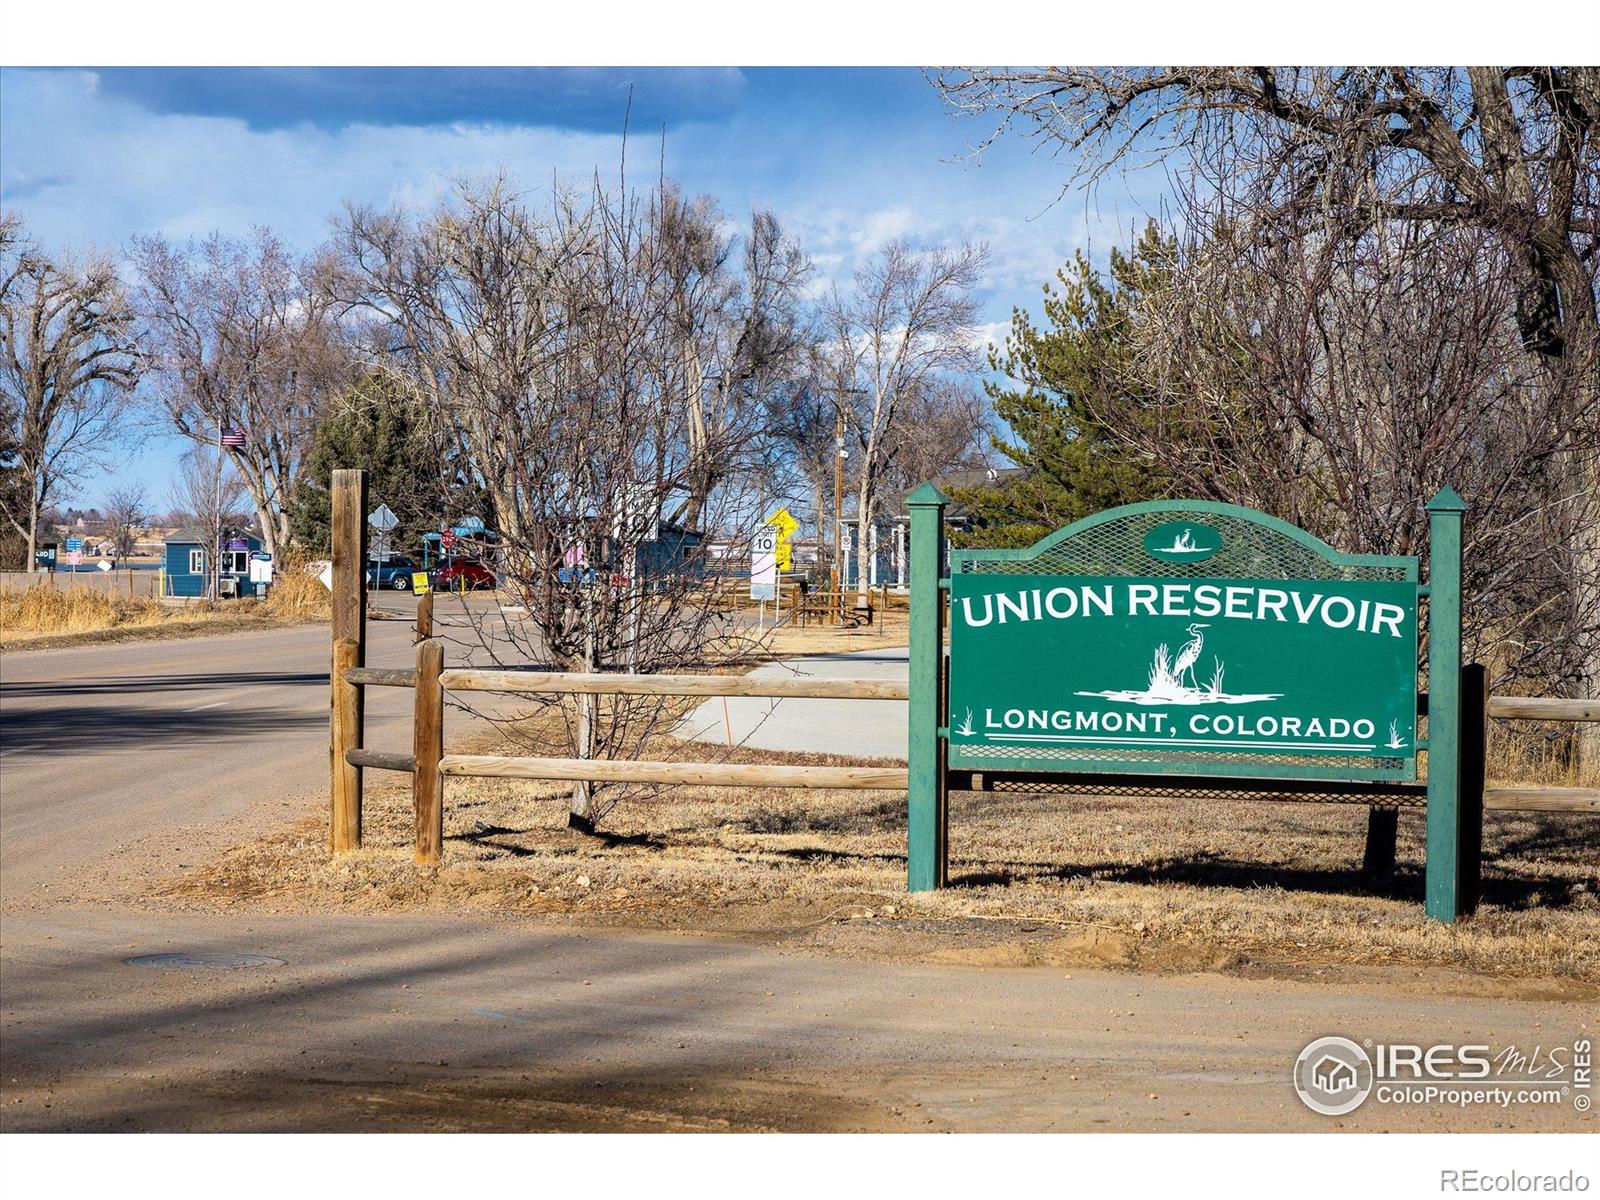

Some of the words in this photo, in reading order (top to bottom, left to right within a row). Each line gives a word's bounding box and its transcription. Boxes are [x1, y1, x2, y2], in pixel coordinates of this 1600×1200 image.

[758, 538, 772, 550] 10
[962, 584, 1114, 626] UNION
[1127, 584, 1407, 638] RESERVOIR
[985, 708, 1178, 737] LONGMONT,
[1190, 713, 1377, 740] COLORADO
